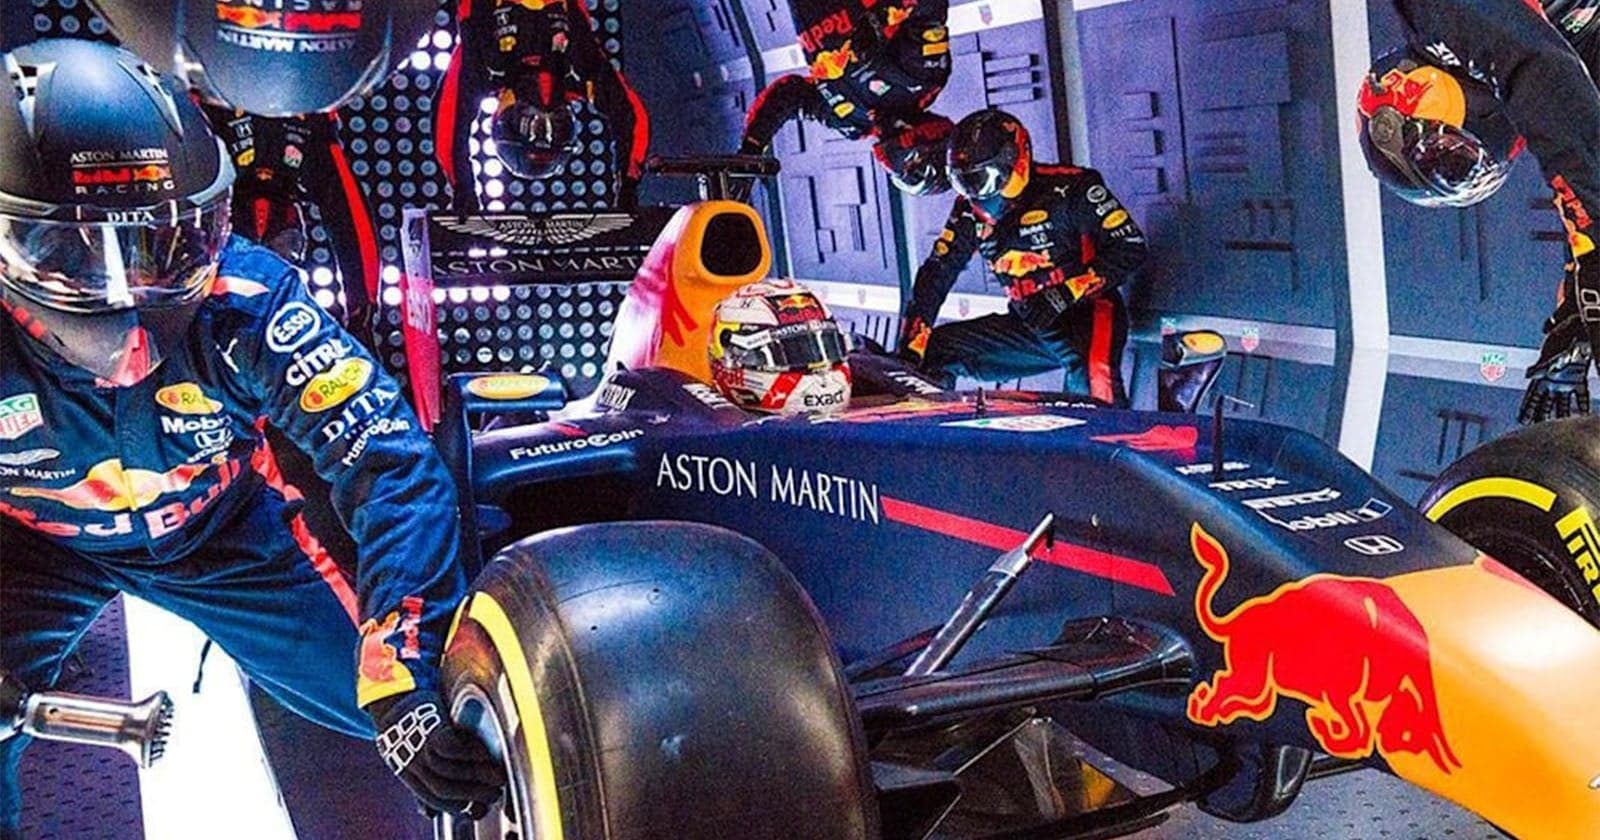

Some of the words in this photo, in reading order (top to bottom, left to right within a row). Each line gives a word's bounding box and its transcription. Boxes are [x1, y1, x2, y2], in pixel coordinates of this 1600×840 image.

[70, 151, 115, 163] ASTON
[120, 148, 169, 160] MARTIN
[75, 180, 175, 194] RACING
[106, 210, 155, 222] DITA
[499, 221, 535, 230] ASTON
[546, 219, 584, 229] MARTIN
[322, 387, 400, 443] DITA
[24, 467, 76, 479] MARTIN
[656, 452, 758, 498] ASTON
[770, 463, 879, 524] MARTIN
[1554, 505, 1600, 606] PIR
